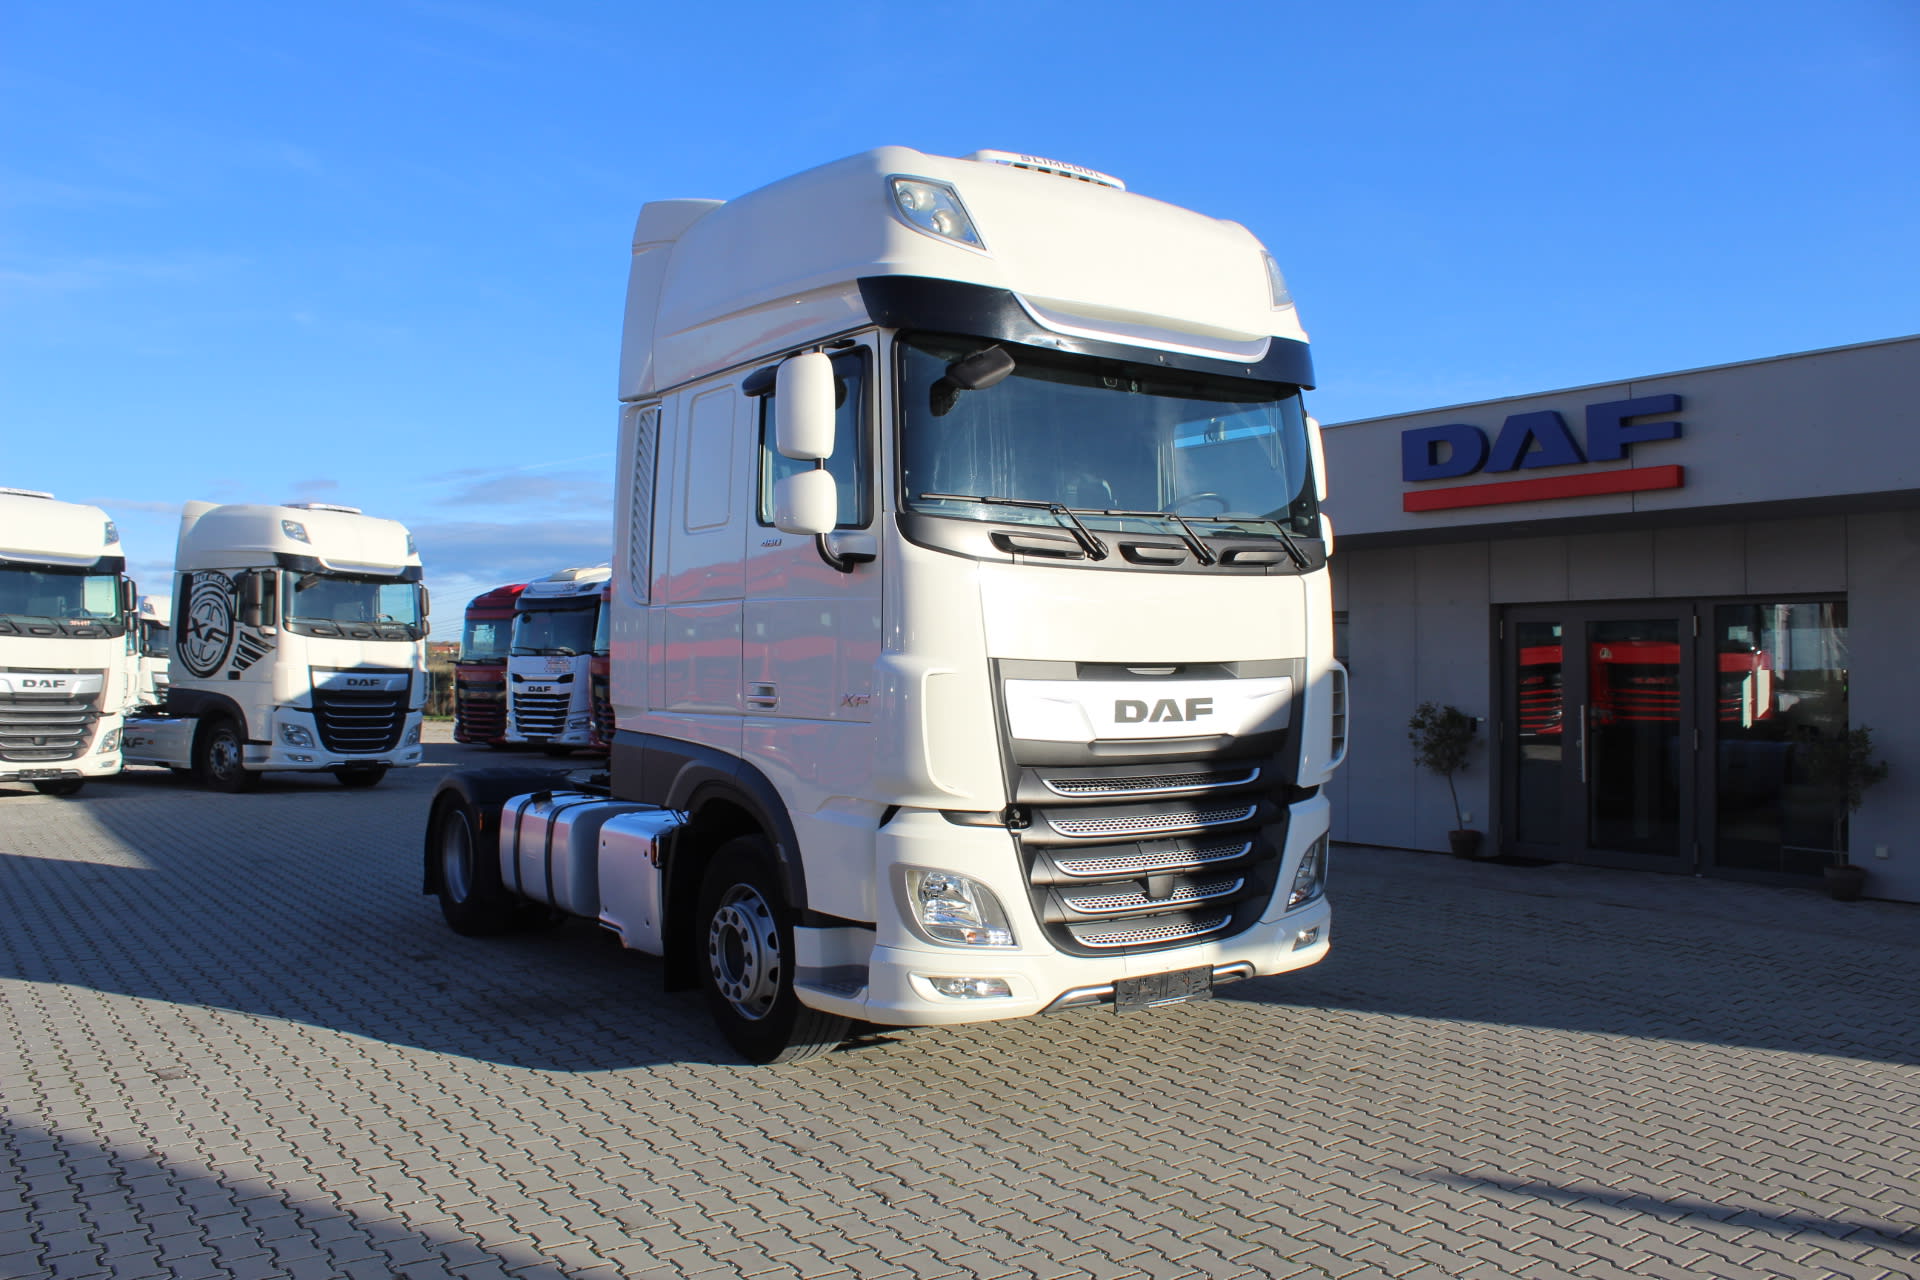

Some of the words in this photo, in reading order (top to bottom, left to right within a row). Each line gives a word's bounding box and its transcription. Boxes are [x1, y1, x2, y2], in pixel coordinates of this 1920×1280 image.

[1401, 394, 1683, 482] DAF
[187, 616, 229, 644] XF
[22, 679, 67, 688] DAF
[346, 678, 380, 687] DAF
[528, 685, 552, 693] DAF
[841, 694, 870, 707] XF
[1114, 697, 1213, 723] DAF
